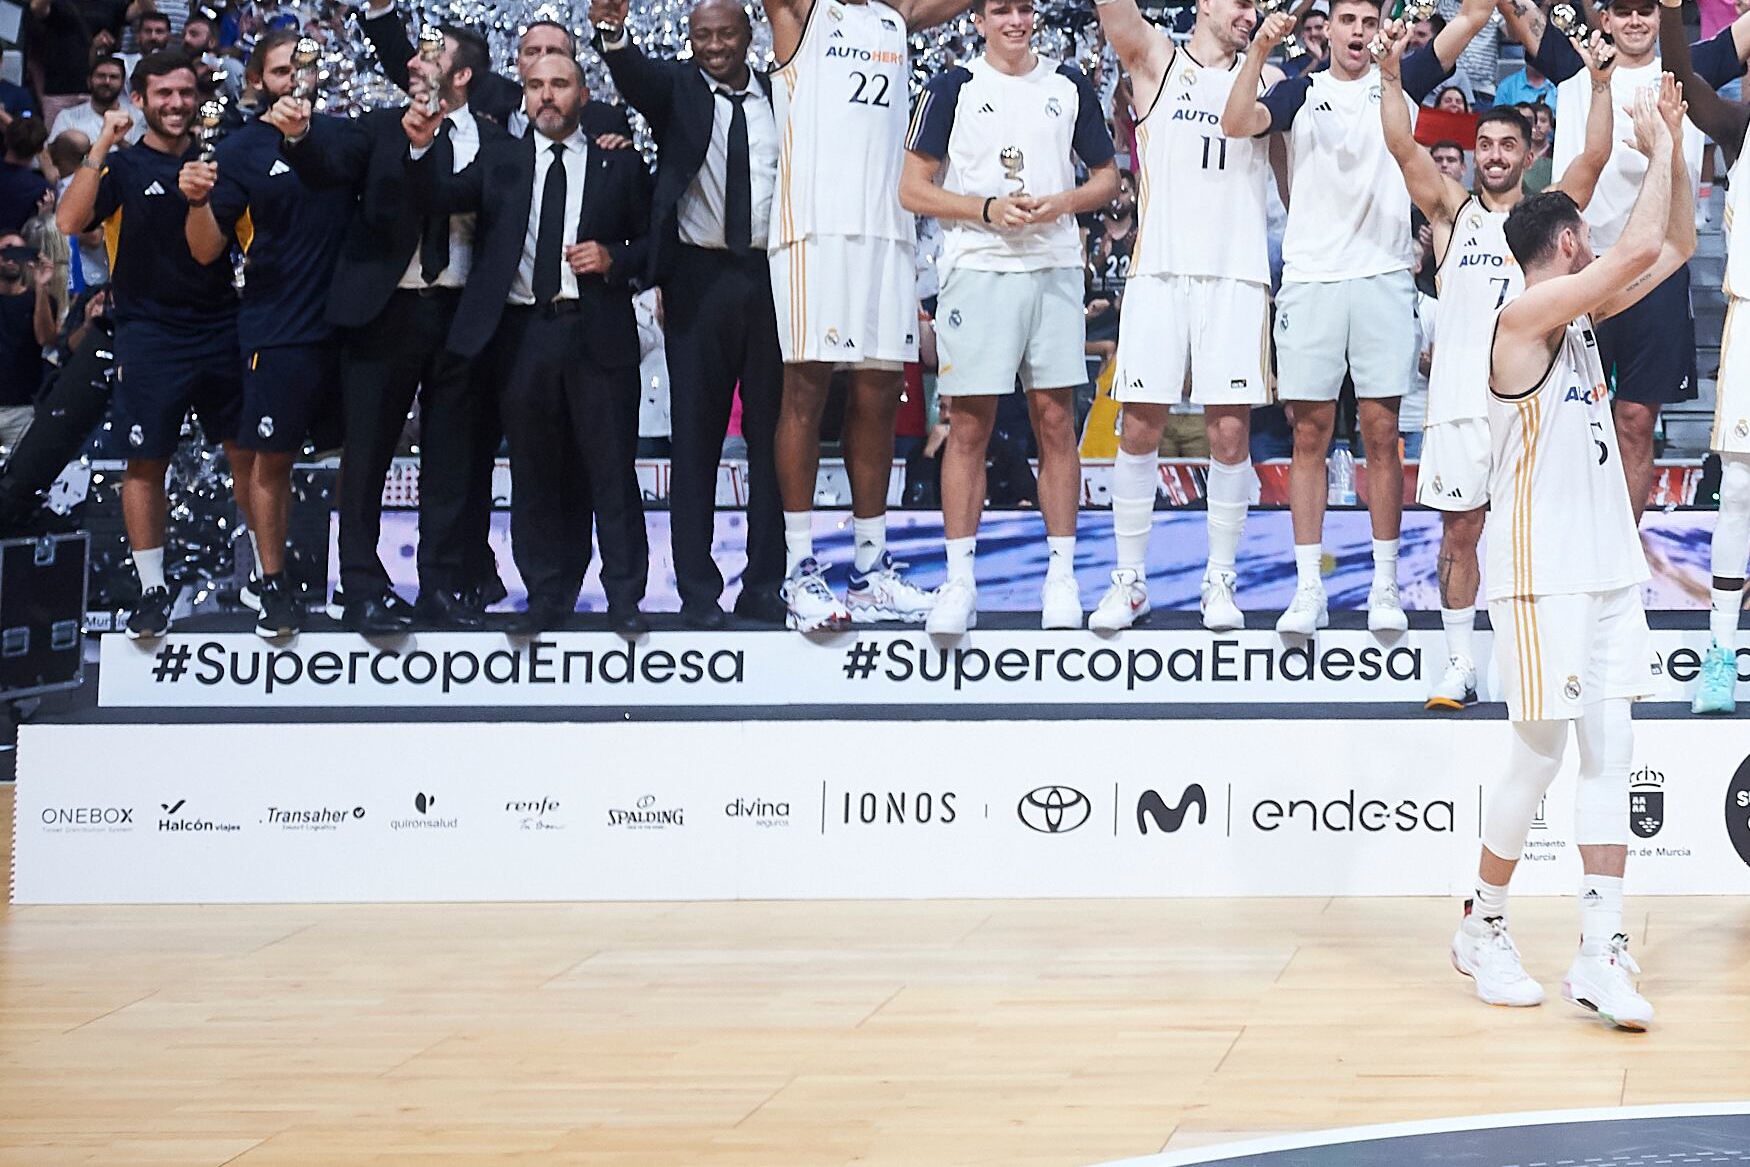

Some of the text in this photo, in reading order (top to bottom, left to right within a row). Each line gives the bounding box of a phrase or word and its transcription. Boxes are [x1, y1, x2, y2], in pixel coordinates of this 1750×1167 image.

[826, 46, 904, 66] AUTOHERO
[848, 71, 890, 107] 22
[1172, 109, 1219, 125] AUTO
[1200, 135, 1226, 170] 11
[1458, 253, 1517, 268] AUTOH
[1489, 277, 1510, 311] 7
[153, 641, 745, 694] #SupercopaEndesa
[843, 640, 1422, 690] #SupercopaEndesa
[267, 807, 349, 823] Transaher
[505, 797, 560, 815] renfe
[725, 797, 790, 817] divina
[843, 791, 957, 824] IONOS
[1252, 789, 1455, 833] endesa
[41, 808, 133, 824] ONEBOX
[158, 818, 213, 832] Halcón
[607, 808, 684, 826] SPALDING
[1524, 840, 1566, 848] tamiento
[1639, 847, 1653, 857] de
[1656, 848, 1691, 857] Murcia
[1524, 853, 1557, 861] Murcia
